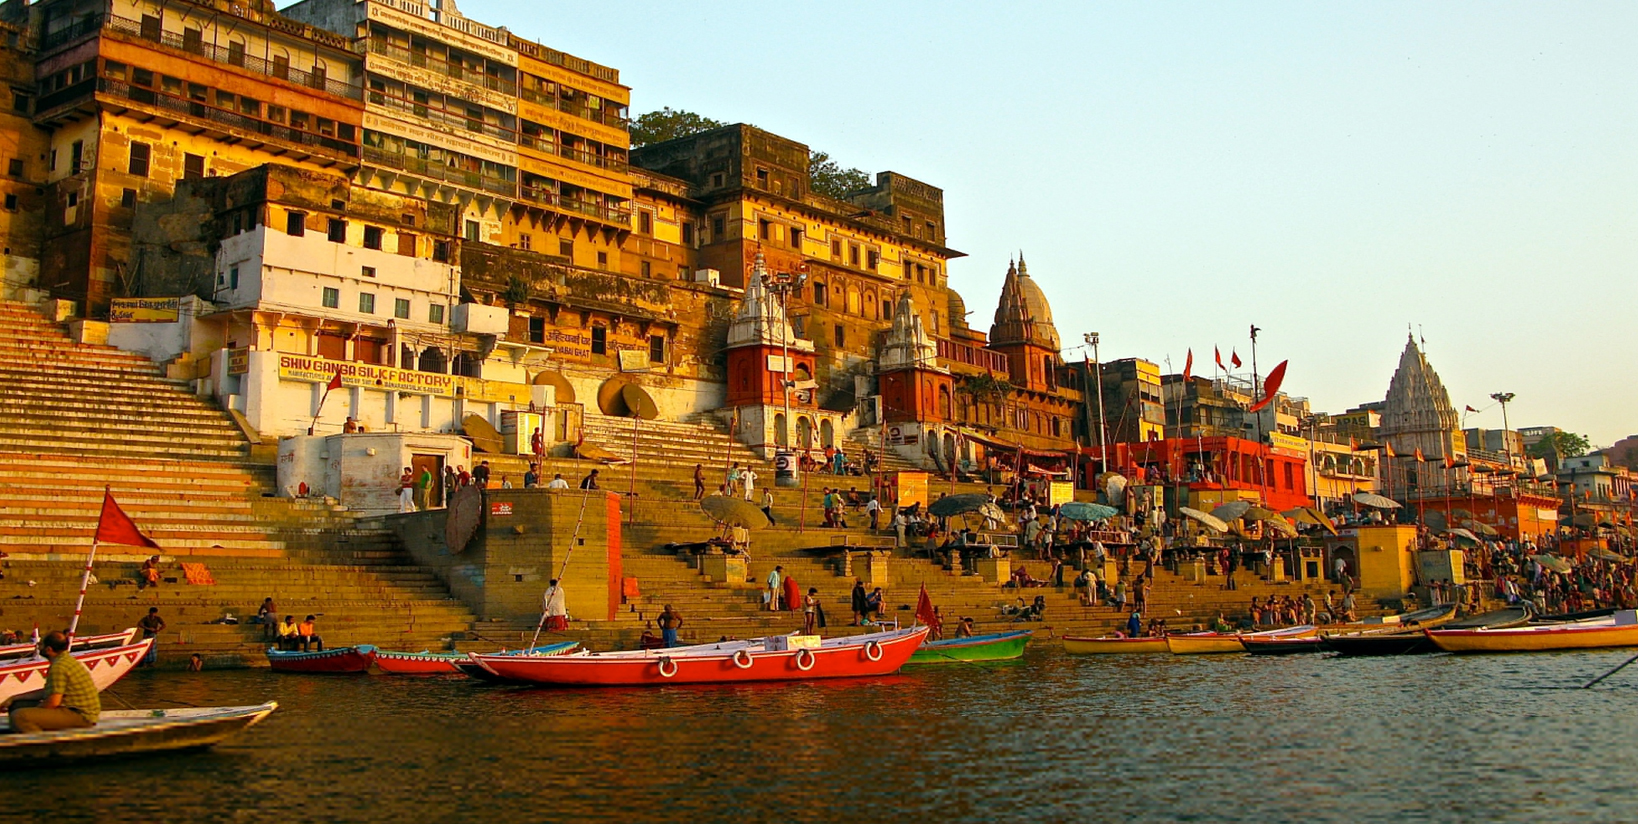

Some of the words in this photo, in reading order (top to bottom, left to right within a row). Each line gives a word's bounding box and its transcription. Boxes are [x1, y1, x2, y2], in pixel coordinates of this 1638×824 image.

[575, 348, 590, 358] GHAT
[281, 356, 311, 371] SHIV
[313, 360, 356, 377] GANGA
[358, 366, 388, 381] SILK
[389, 370, 452, 388] FACTORY
